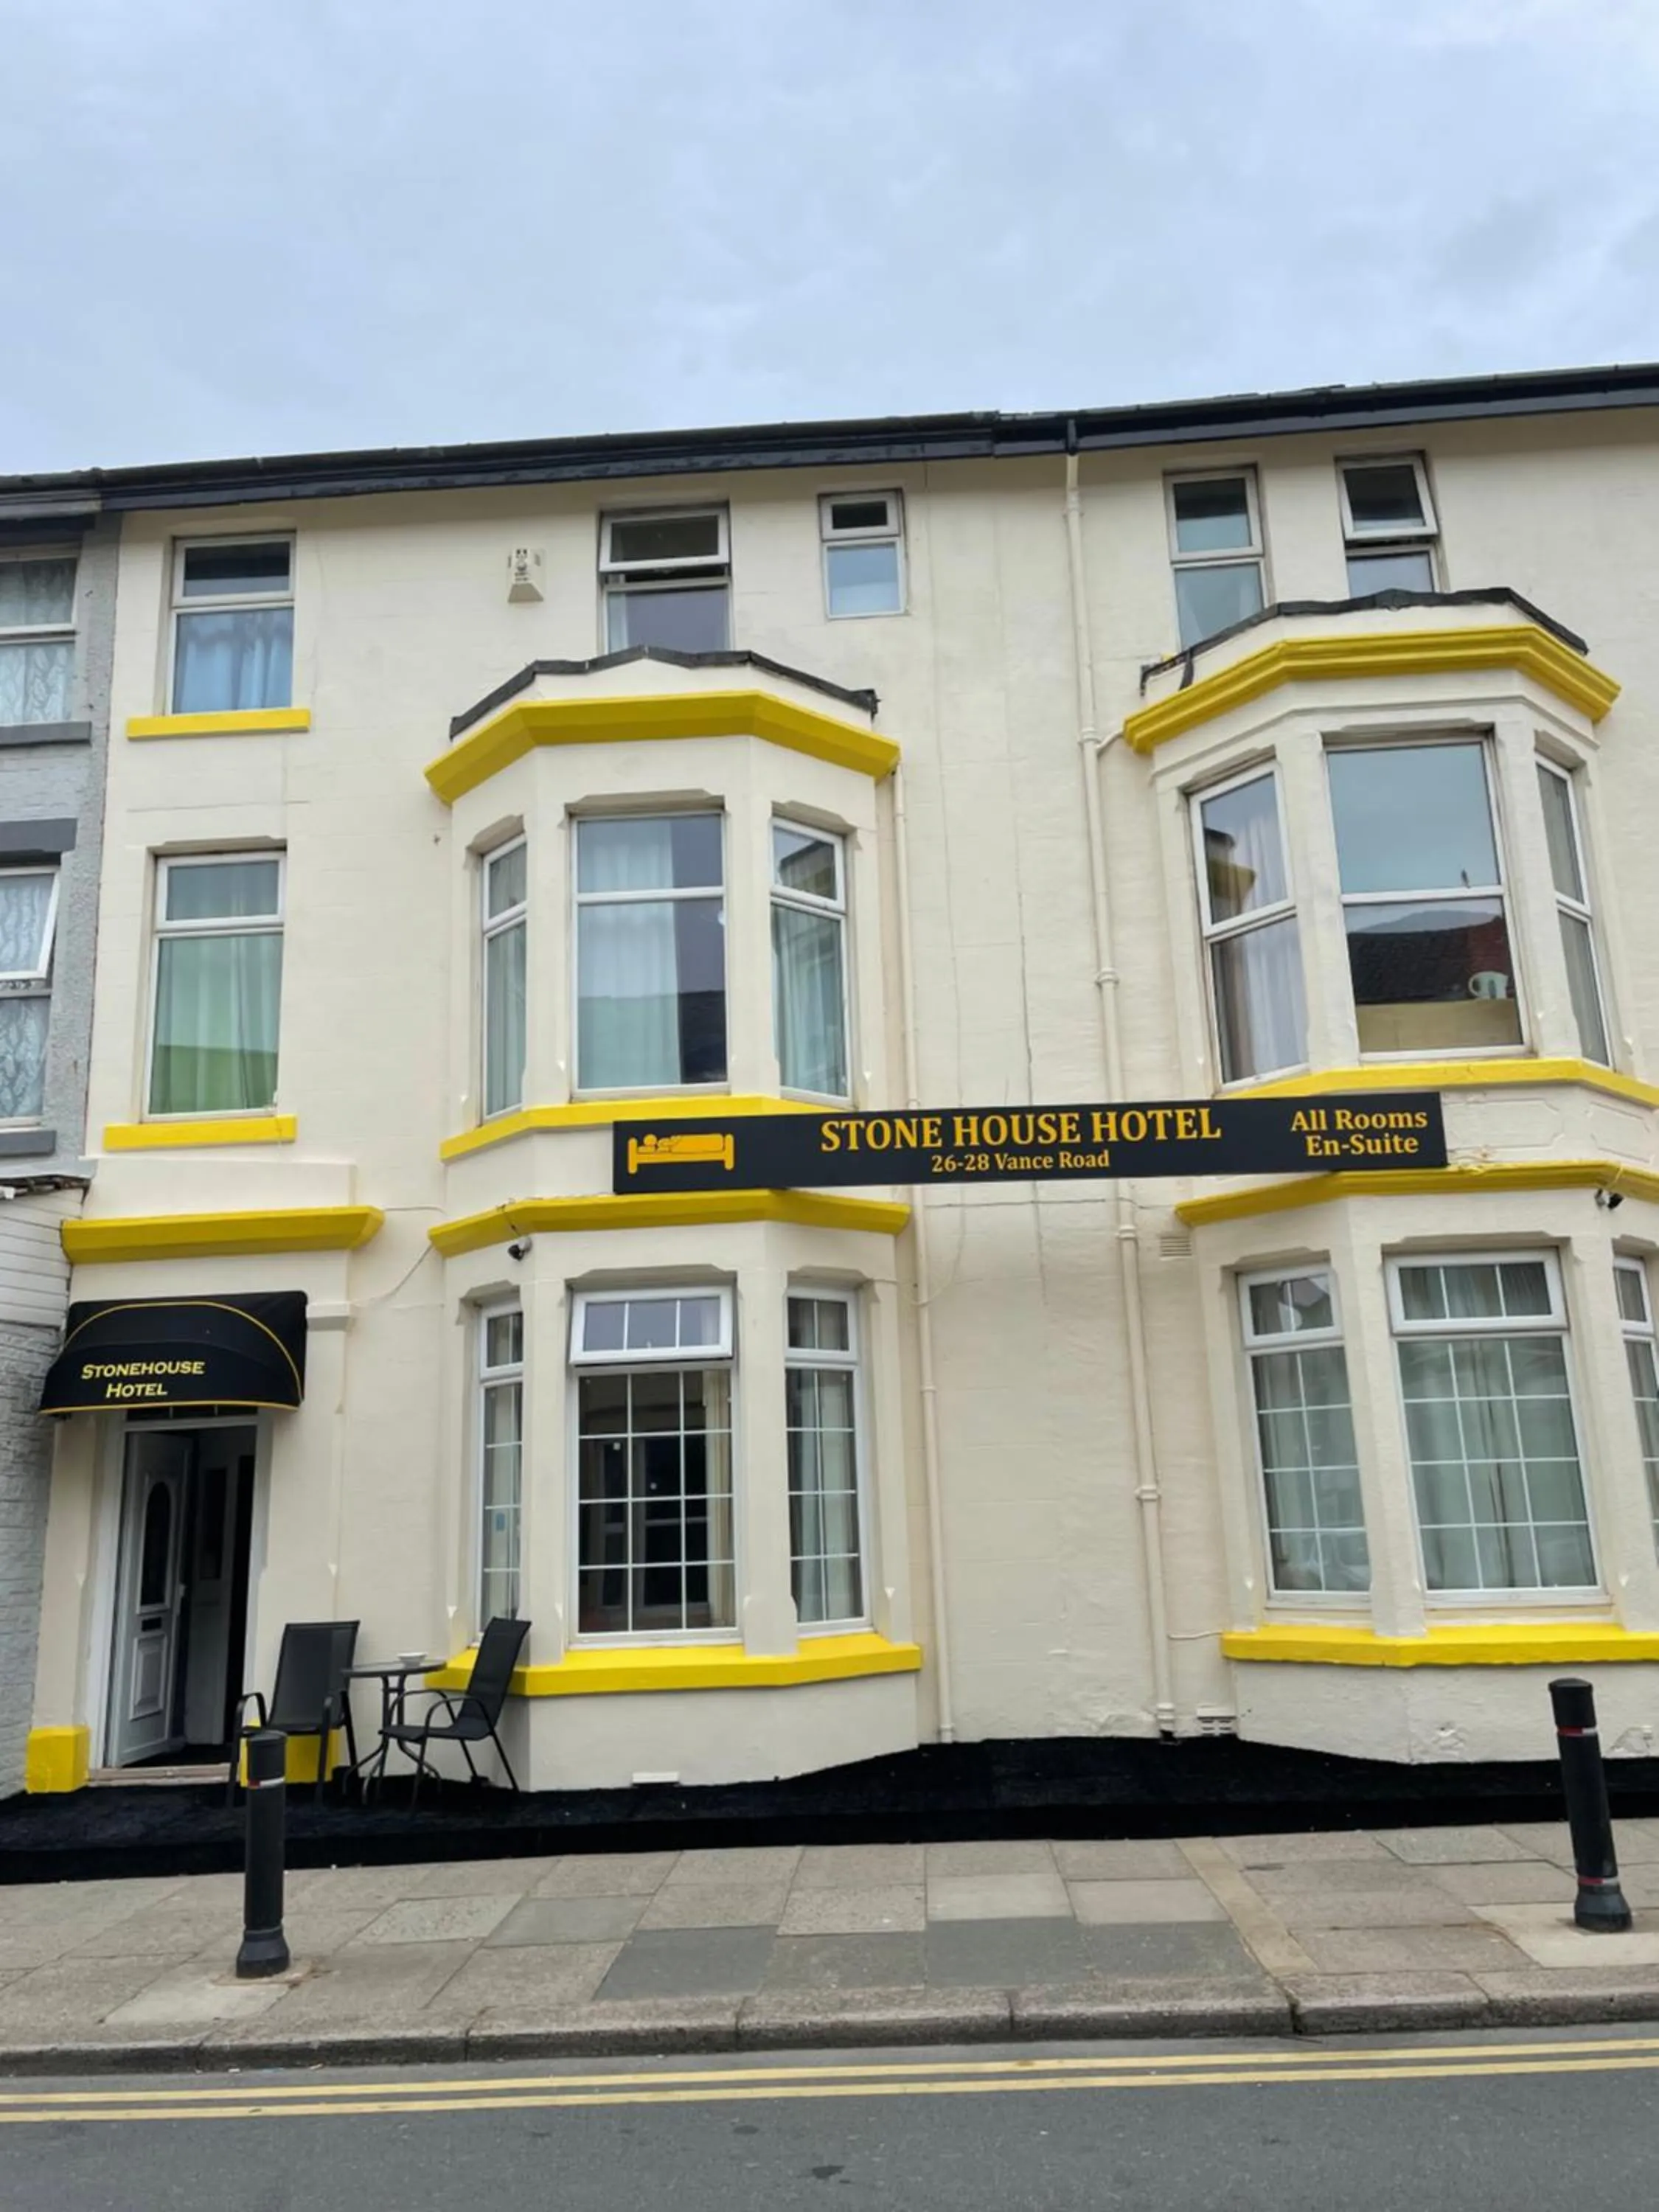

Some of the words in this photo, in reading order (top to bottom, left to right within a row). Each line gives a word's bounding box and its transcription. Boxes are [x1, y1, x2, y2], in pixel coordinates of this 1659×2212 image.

[820, 1117, 942, 1152] STONE
[953, 1112, 1081, 1147] HOUSE
[1091, 1107, 1222, 1143] HOTEL
[1291, 1109, 1328, 1132] All
[1335, 1109, 1428, 1130] Rooms
[1305, 1132, 1419, 1156] En-Suite
[931, 1153, 990, 1172] 26-28
[994, 1152, 1054, 1170] Vance
[1059, 1150, 1110, 1169] Road
[81, 1360, 205, 1380] STONEHOUSE
[105, 1382, 168, 1399] HOTEL
